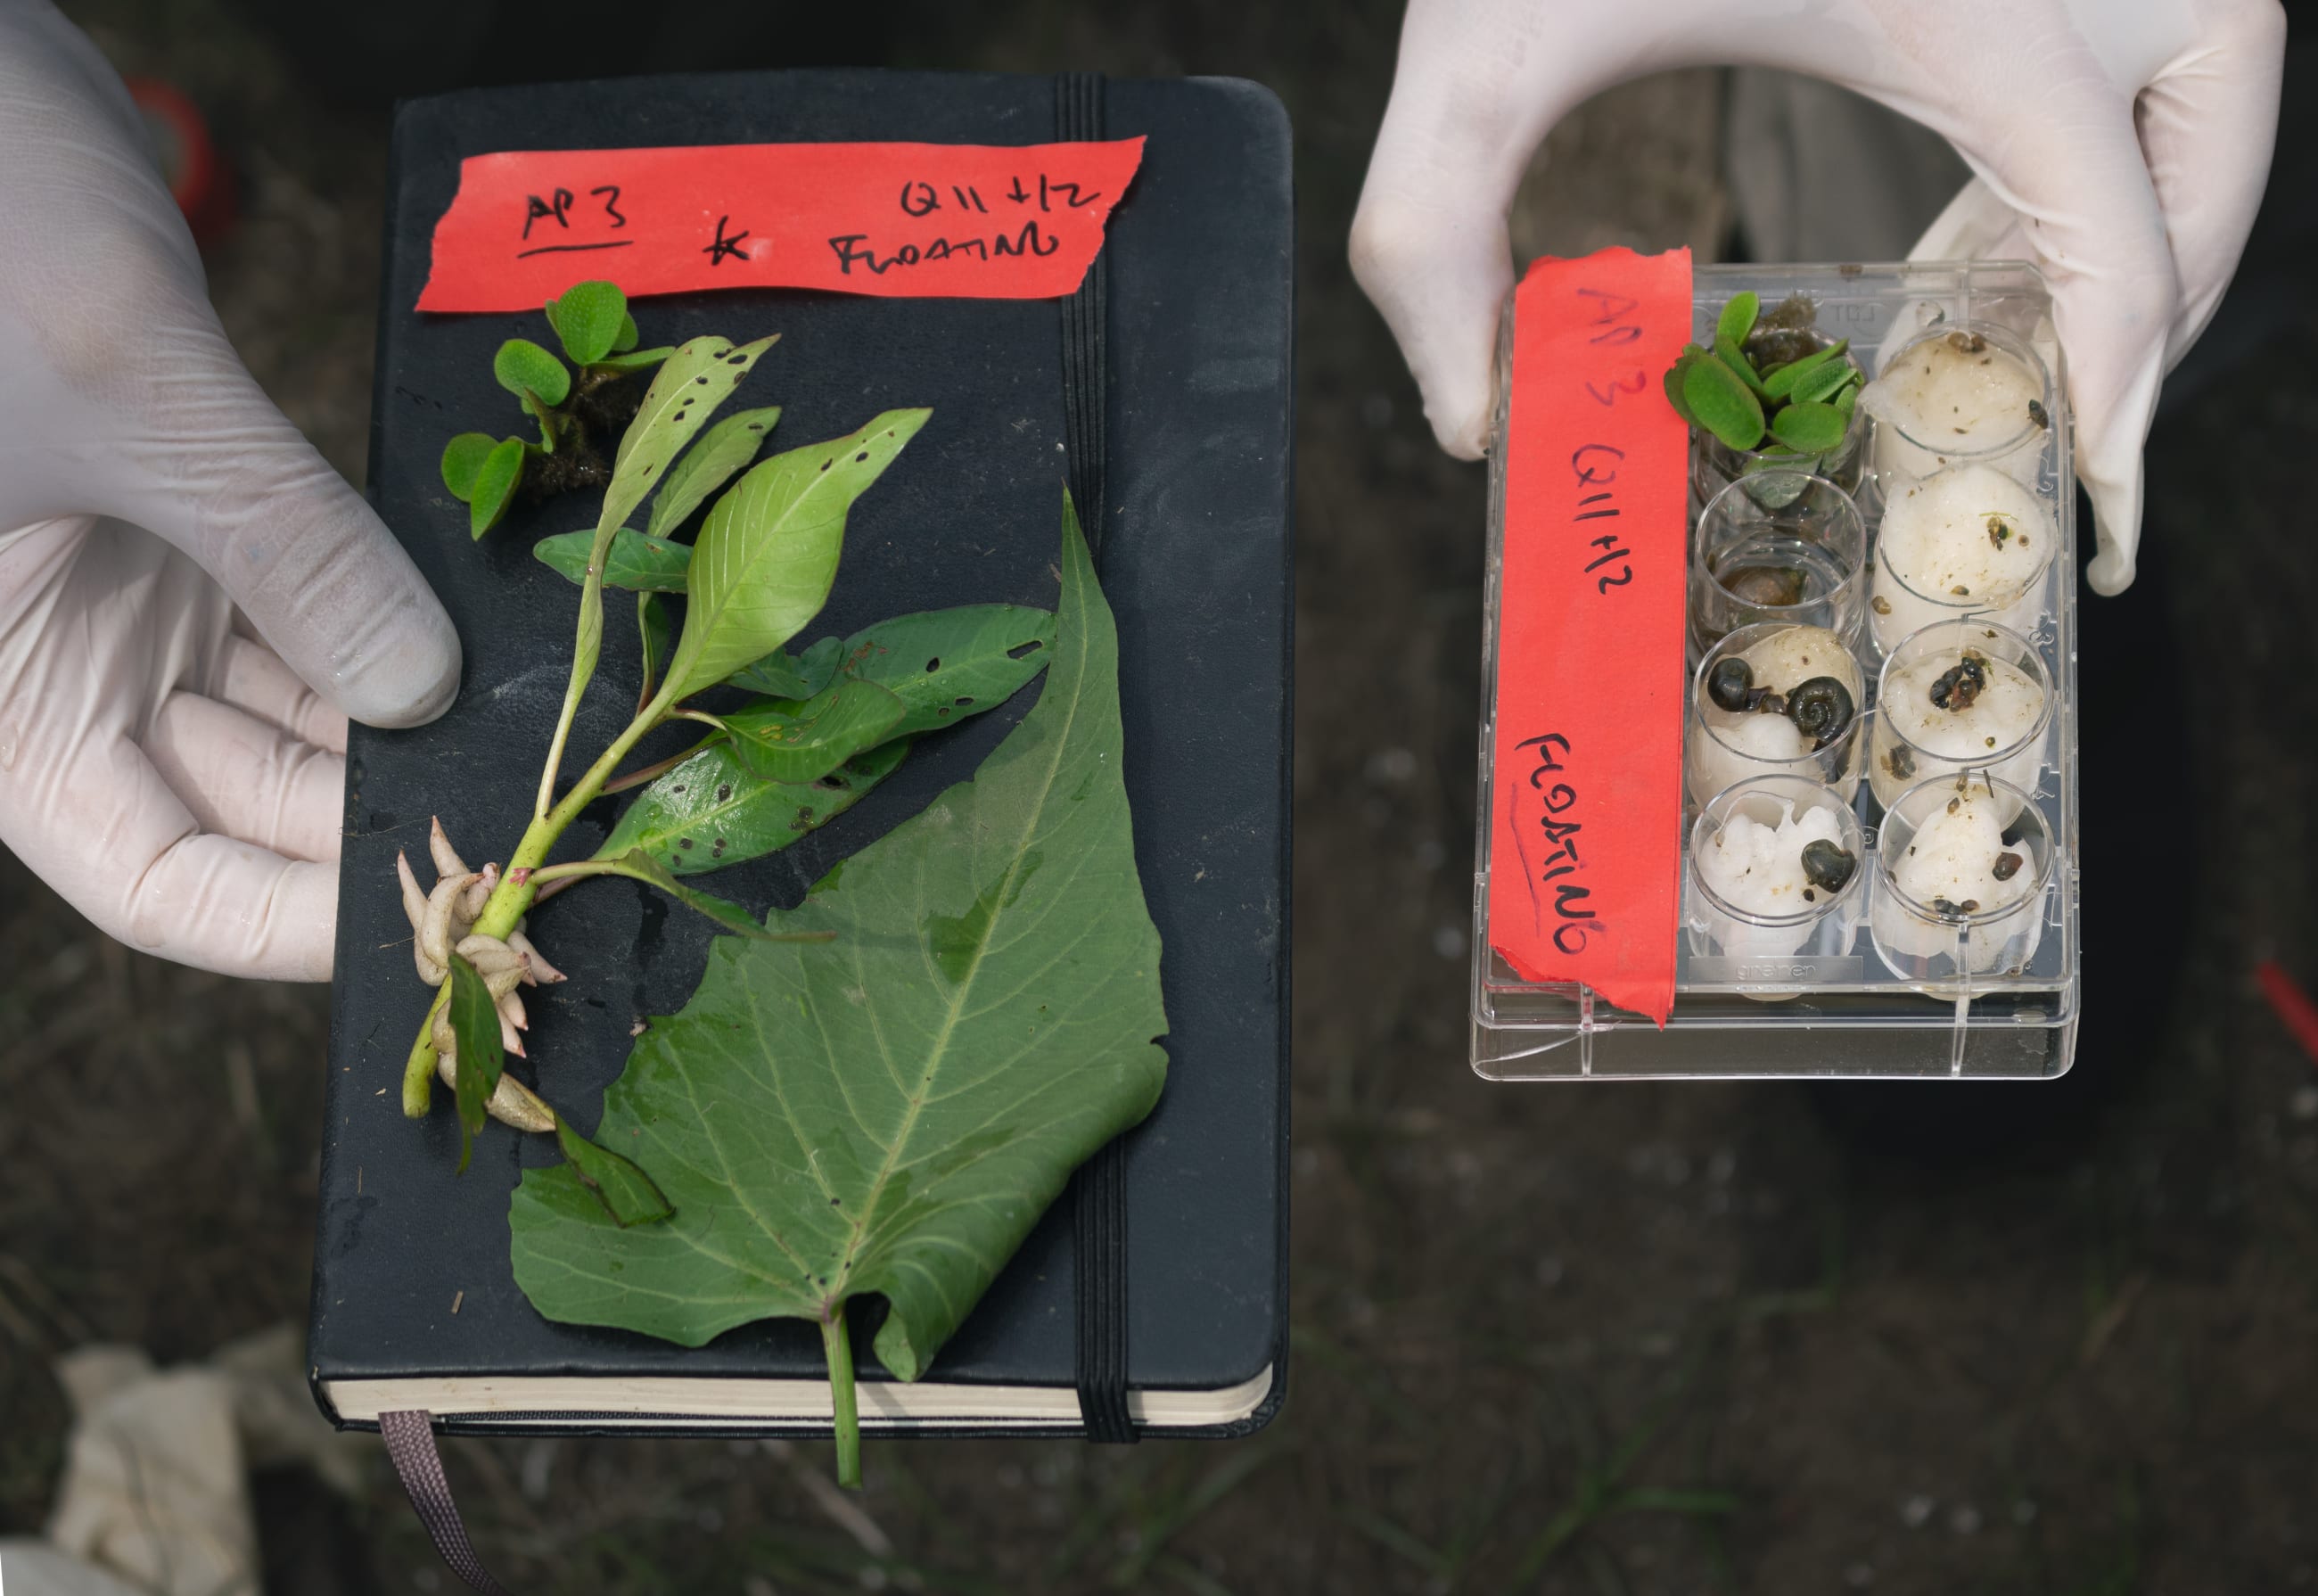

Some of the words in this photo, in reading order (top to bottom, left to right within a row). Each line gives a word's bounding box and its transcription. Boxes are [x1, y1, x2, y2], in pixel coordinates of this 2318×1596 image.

[522, 186, 574, 241] AP
[589, 185, 627, 229] 3
[827, 219, 1060, 275] FLOATING
[1576, 288, 1643, 346] AP
[1585, 370, 1647, 407] 3
[1514, 732, 1606, 956] FLOATING
